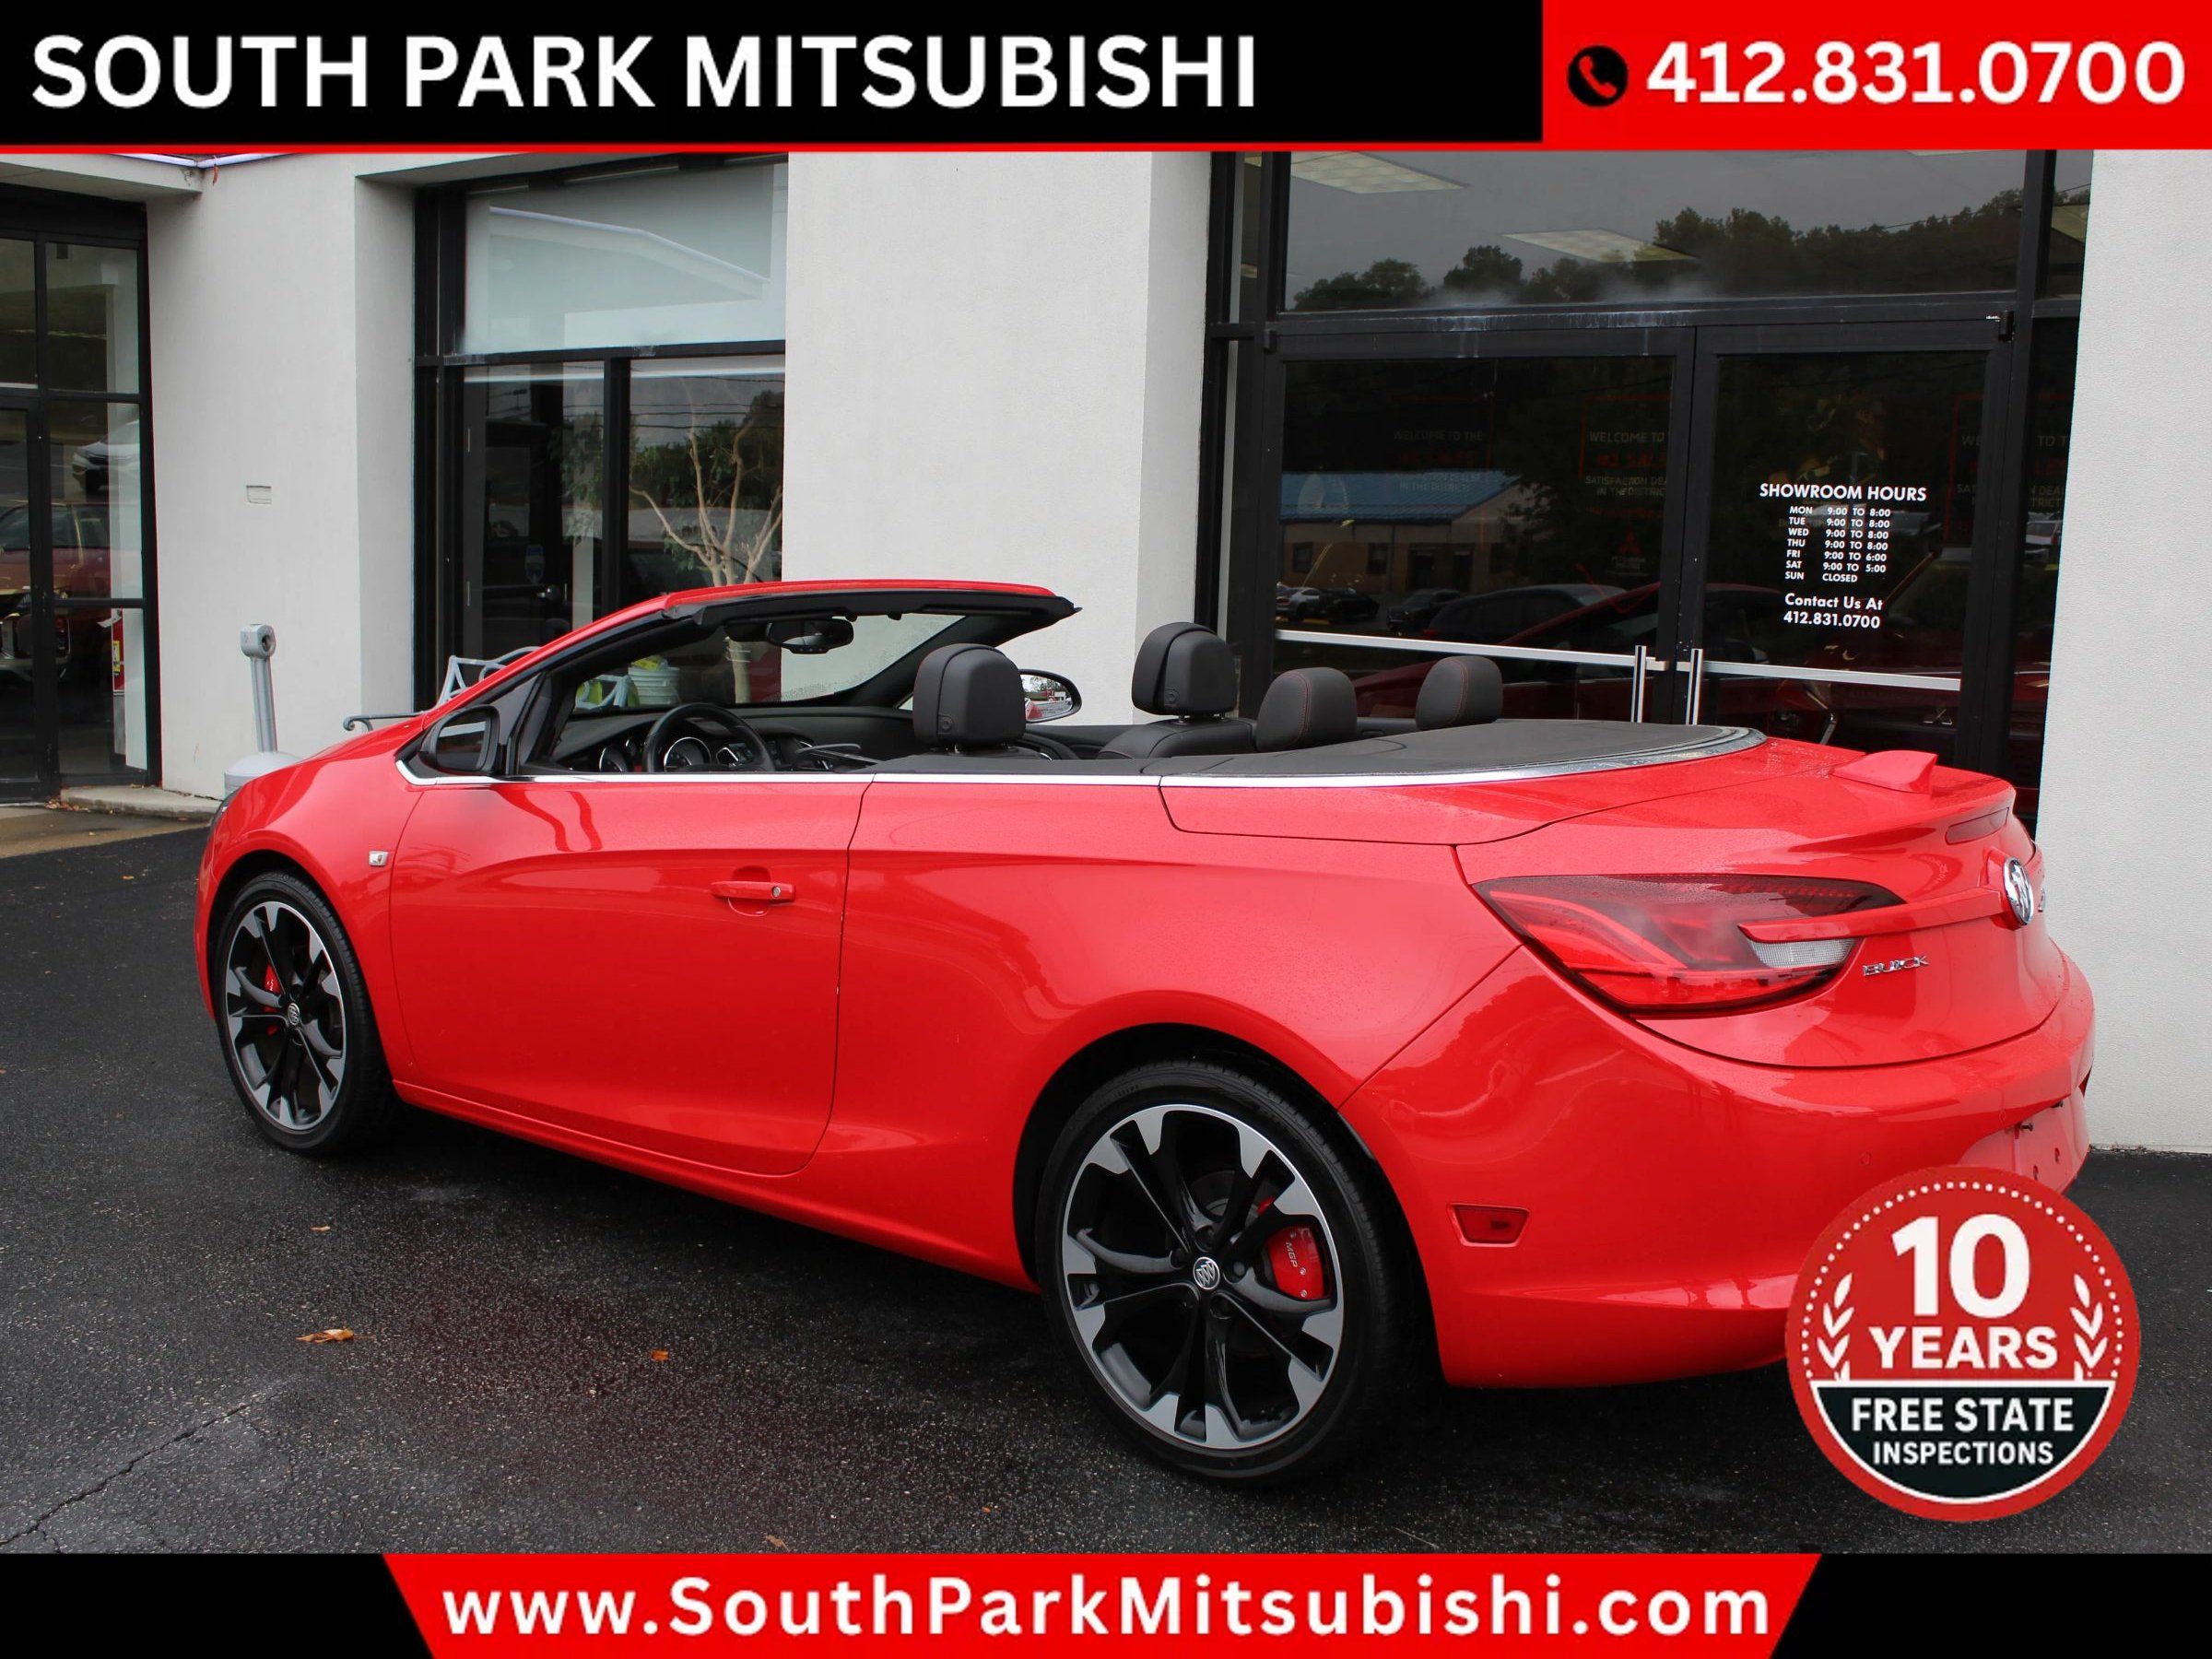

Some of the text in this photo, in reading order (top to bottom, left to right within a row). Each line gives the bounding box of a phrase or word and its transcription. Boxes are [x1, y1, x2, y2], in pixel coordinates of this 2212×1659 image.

[1589, 430, 1665, 442] WELCOME TO
[1759, 483, 1925, 500] SHOWROOM HOURS
[1789, 505, 1890, 516] MON 9:00 TO 8:00
[1788, 516, 1889, 527] TUE 9:00 TO 8:00
[1788, 527, 1888, 539] WED 9:00 TO 8:00
[1787, 538, 1888, 550] THU 9:00 TO 8:00
[1786, 549, 1886, 561] FRI 9:00 TO 6:00
[1785, 559, 1886, 572] SAT 9:00 TO 5:00
[1784, 571, 1857, 582] SUN CLOSED
[1784, 593, 1882, 609] Contact Us At
[1783, 610, 1879, 628] 412.831.0700
[1863, 955, 1930, 976] BUICK
